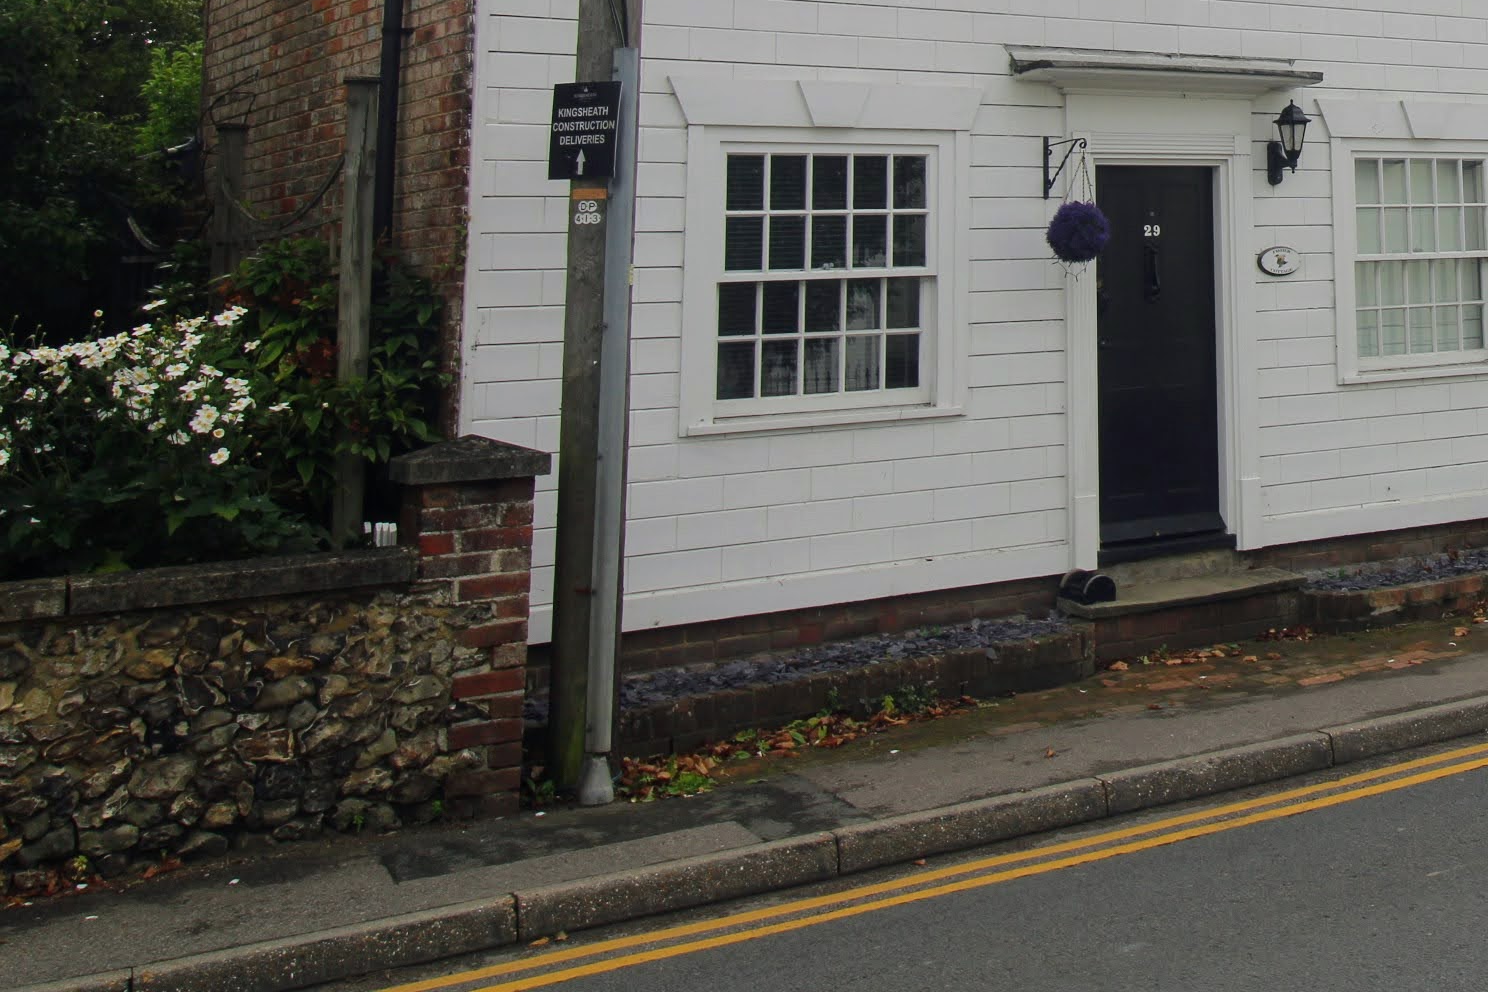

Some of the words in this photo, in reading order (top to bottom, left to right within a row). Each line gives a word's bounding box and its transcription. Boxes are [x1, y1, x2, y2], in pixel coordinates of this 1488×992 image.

[558, 106, 609, 118] KINGSHEATH
[553, 120, 615, 131] CONSTRUCTION
[560, 135, 605, 145] DELIVERIES
[579, 202, 597, 211] DP
[575, 213, 600, 223] 413
[1144, 224, 1160, 236] 29
